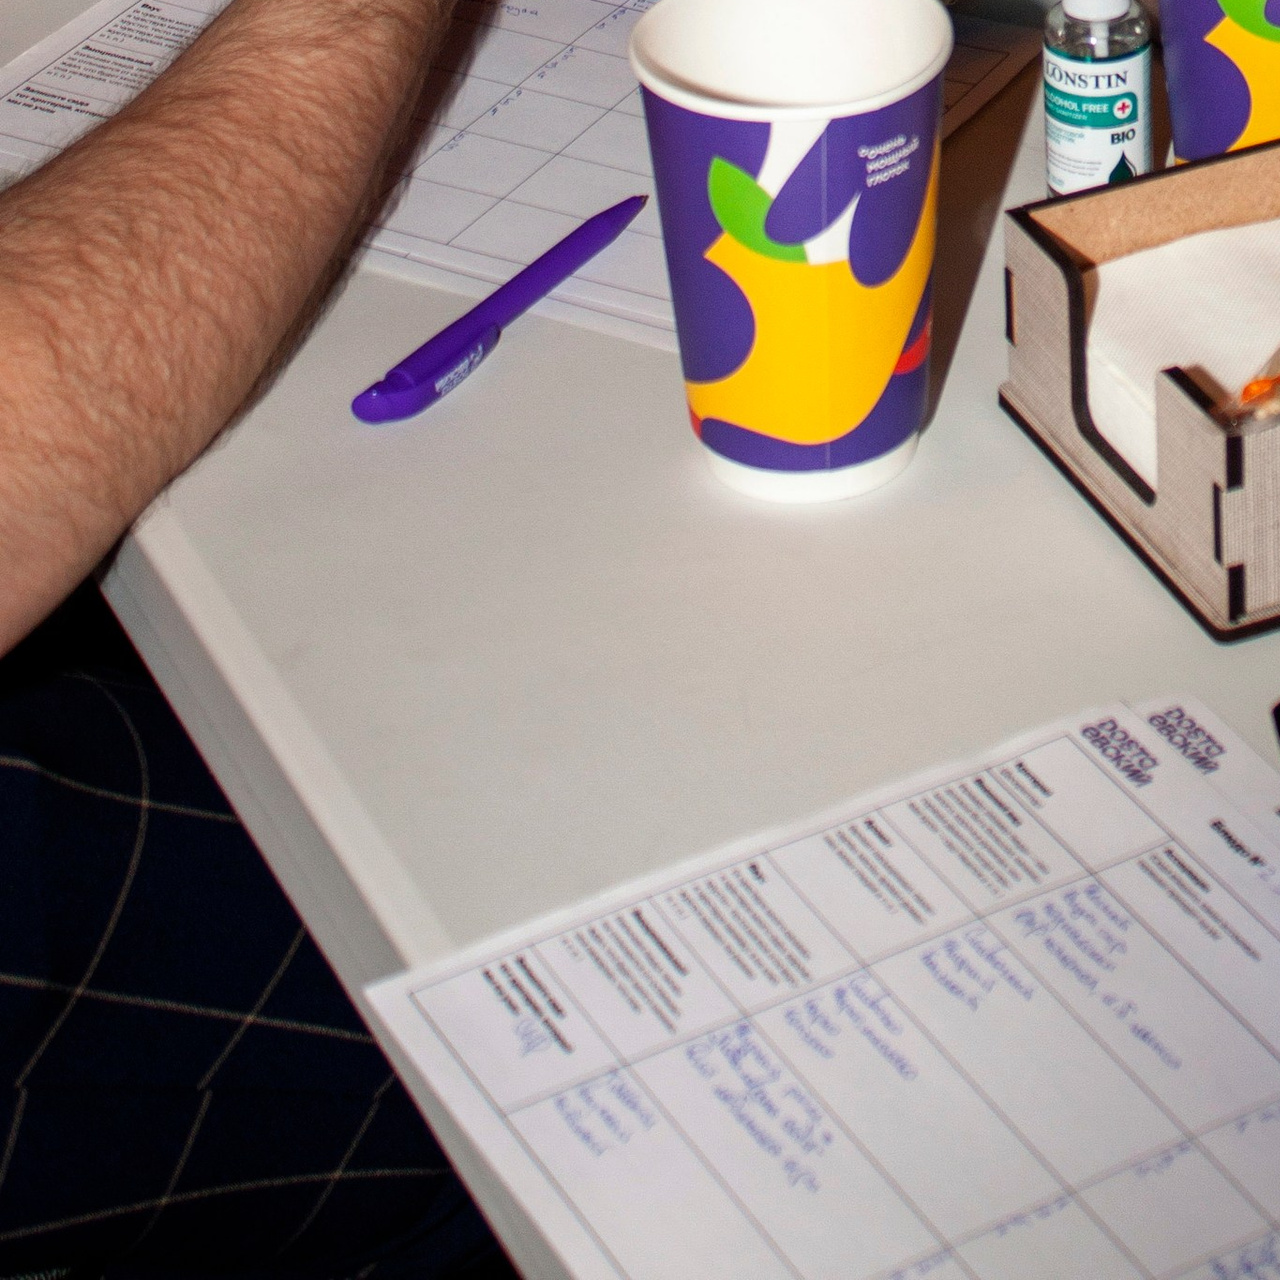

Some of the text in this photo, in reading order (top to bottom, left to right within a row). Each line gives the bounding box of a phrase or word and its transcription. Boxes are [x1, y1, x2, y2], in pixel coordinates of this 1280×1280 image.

[1081, 102, 1110, 114] FREE
[1110, 129, 1136, 146] BIO
[866, 136, 920, 174] мощный
[866, 159, 910, 188] глоток
